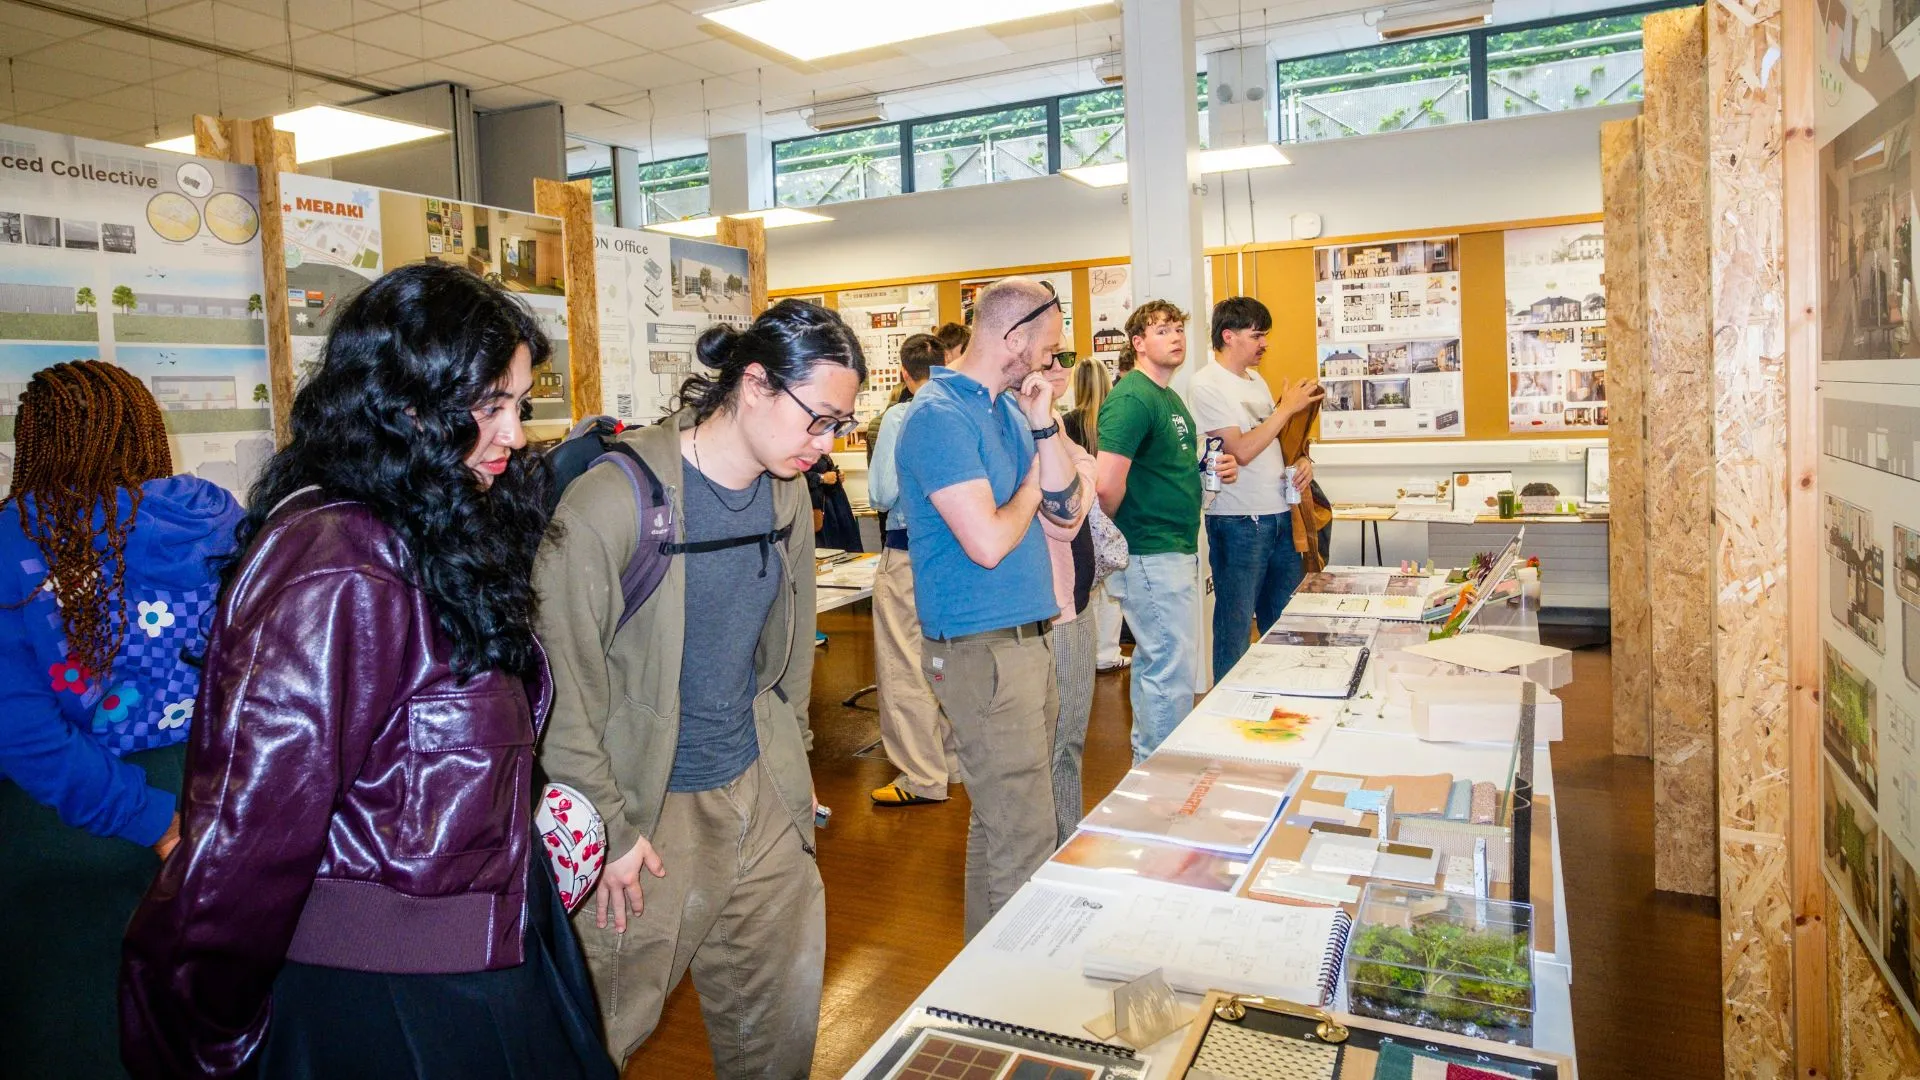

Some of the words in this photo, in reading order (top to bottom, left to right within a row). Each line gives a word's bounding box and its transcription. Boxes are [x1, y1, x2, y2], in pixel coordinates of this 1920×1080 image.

[1, 155, 43, 173] ced
[51, 160, 158, 189] Collective
[296, 197, 363, 219] MERAKI
[614, 239, 649, 255] Office
